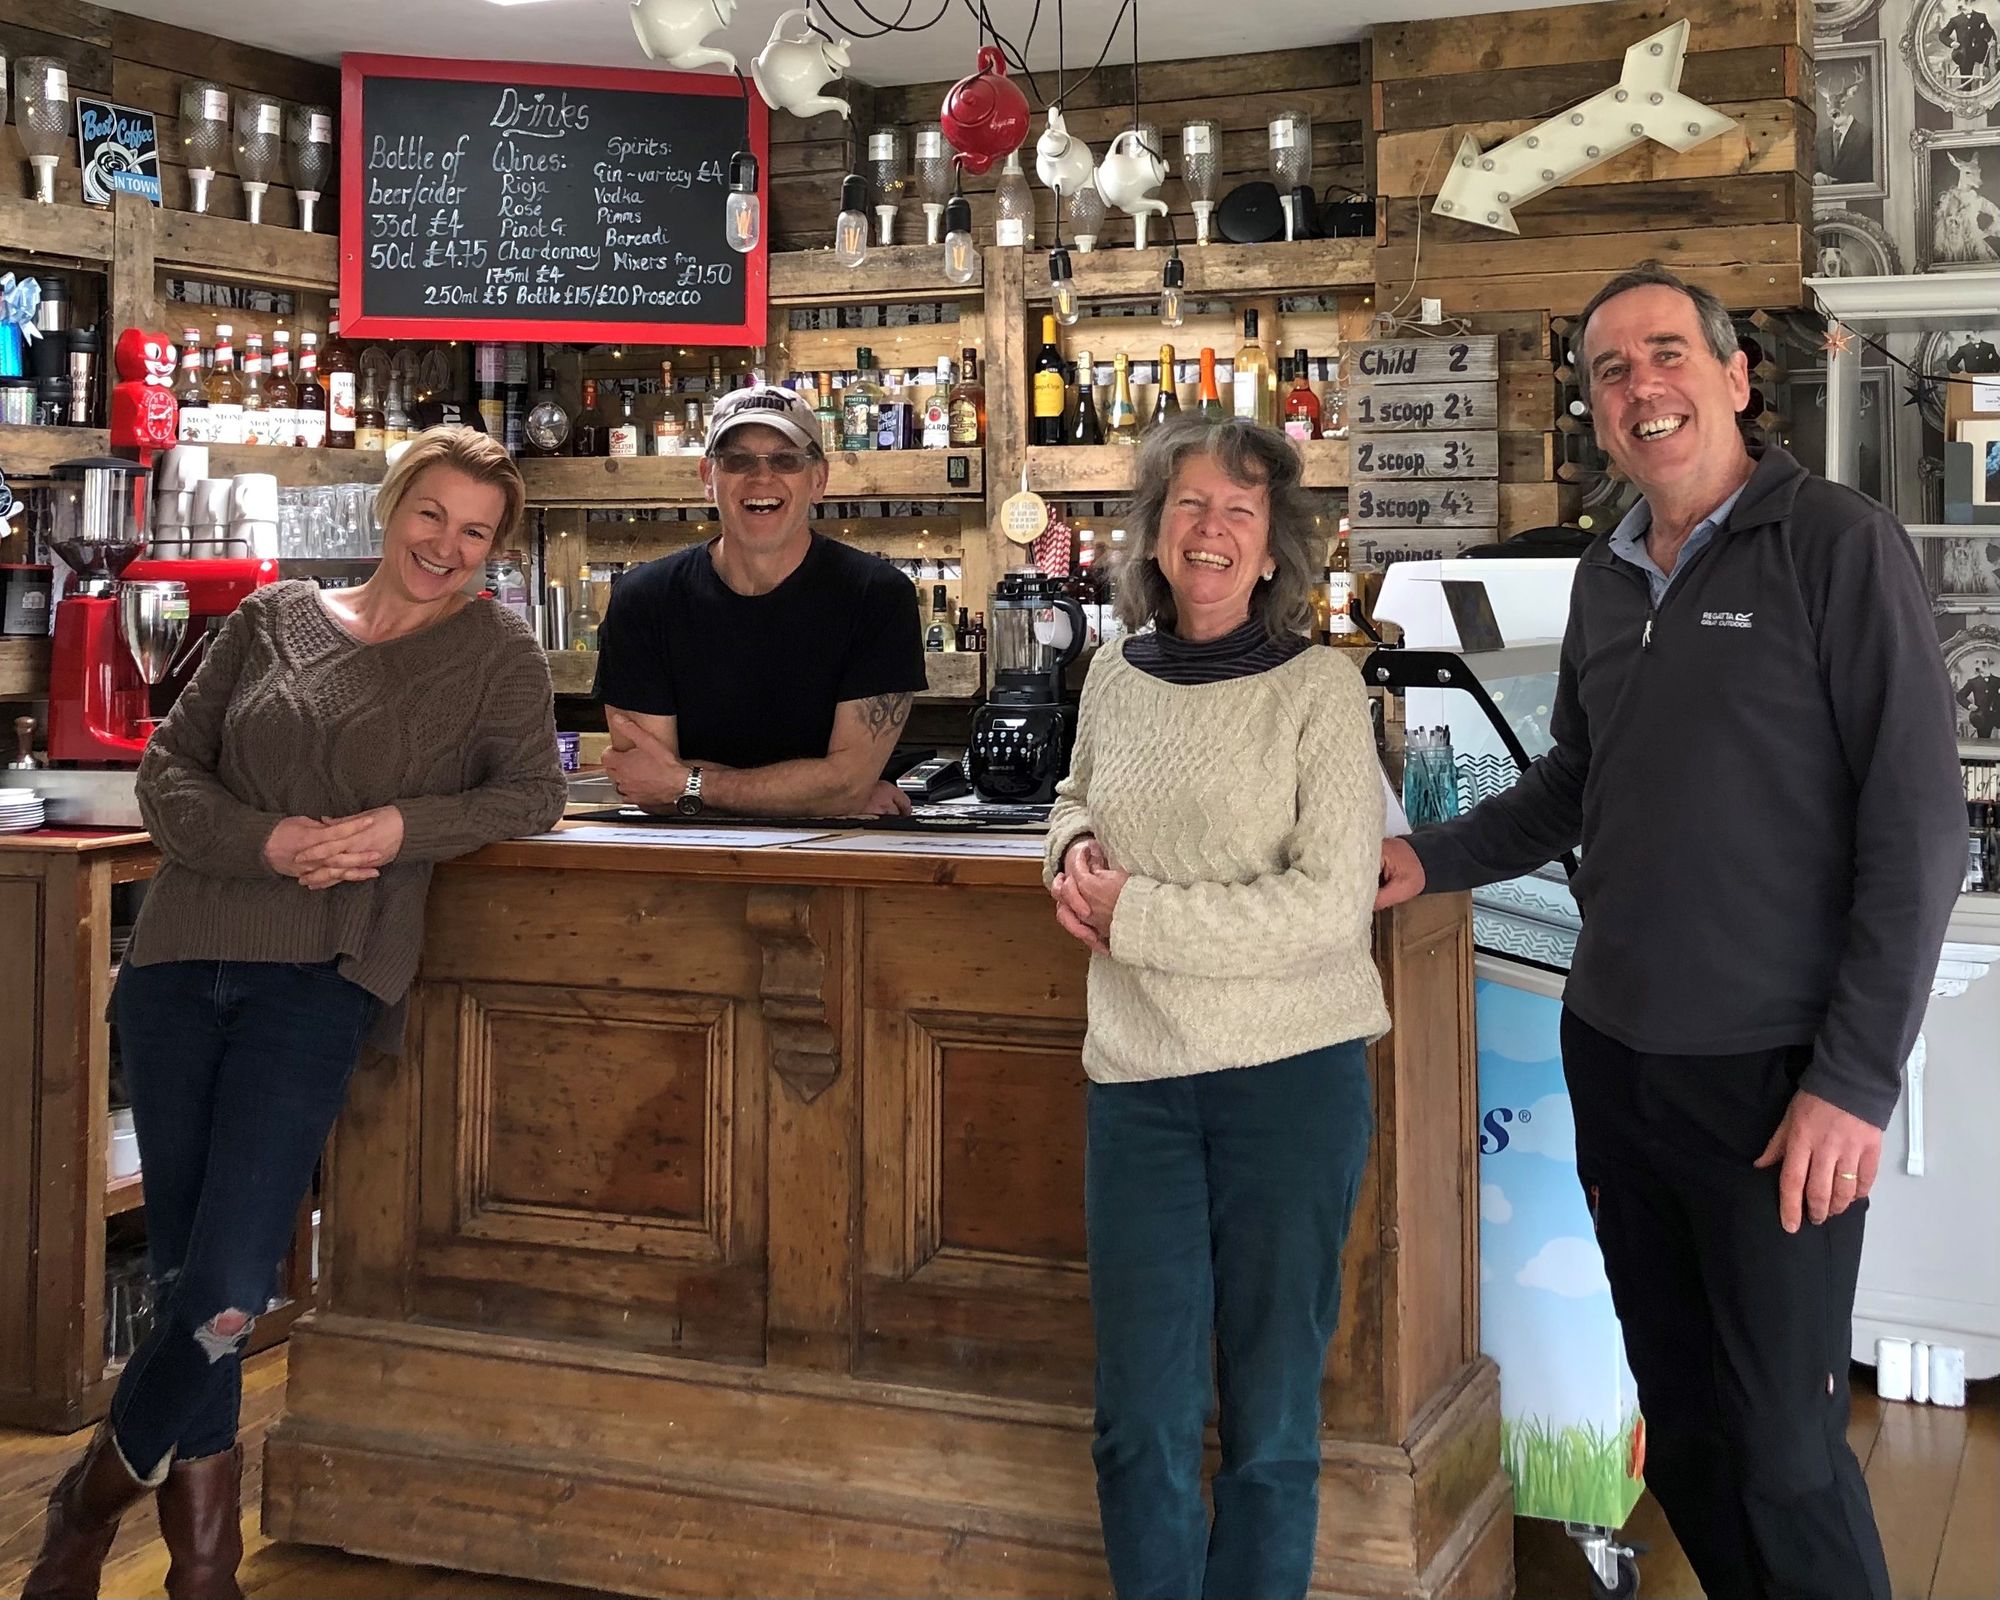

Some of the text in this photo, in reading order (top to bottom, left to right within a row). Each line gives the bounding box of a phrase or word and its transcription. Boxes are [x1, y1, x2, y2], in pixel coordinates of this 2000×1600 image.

[490, 87, 589, 130] Drinks
[82, 110, 154, 148] Best Coffee
[369, 134, 470, 184] Bottle of
[493, 141, 567, 172] Wines:
[607, 136, 672, 163] Spirits:
[114, 175, 159, 194] IN TOWN
[593, 161, 622, 183] Gin
[696, 160, 724, 185] £4
[368, 174, 468, 212] beer/cider
[501, 173, 551, 202] Rioja
[594, 186, 645, 204] Vodka
[425, 208, 464, 238] £4
[500, 217, 550, 238] Pinot
[596, 207, 642, 225] Pimms
[422, 240, 488, 268] £4.75
[498, 240, 601, 270] Chardonnay
[613, 251, 668, 271] Mixers
[486, 264, 565, 284] 175ml £4
[677, 263, 733, 286] £1.50
[424, 285, 478, 305] 250ml
[482, 285, 508, 305] £5
[516, 285, 562, 304] Bottle
[631, 284, 702, 306] Prosecco
[1359, 343, 1470, 375] Child 2
[1357, 396, 1376, 423] 1
[1379, 400, 1434, 427] scoop
[1357, 442, 1375, 472] 2
[1377, 451, 1426, 476] scoop
[1358, 490, 1375, 519] 3
[1375, 498, 1431, 525] scoop
[1702, 611, 1734, 620] REGATTA
